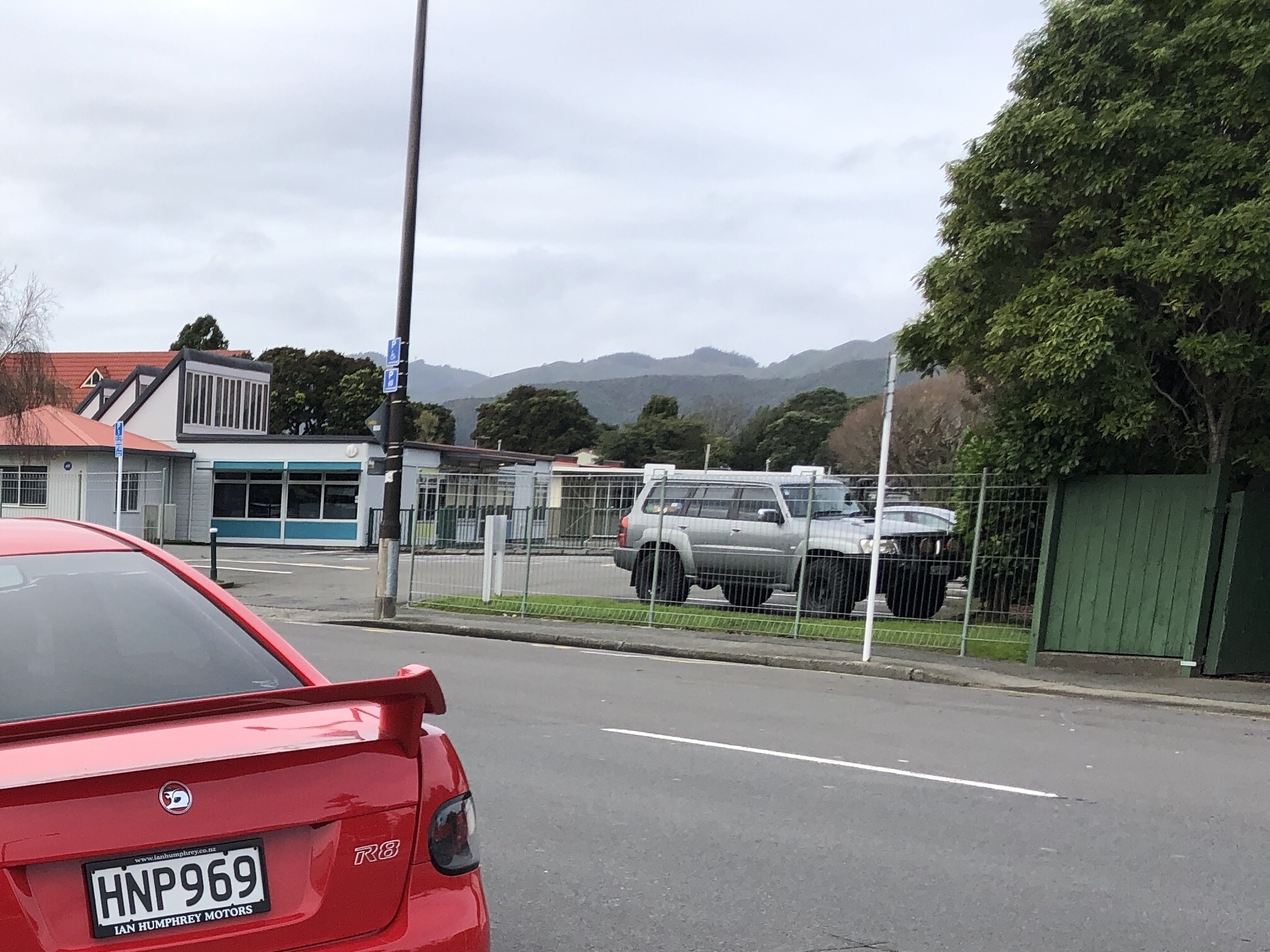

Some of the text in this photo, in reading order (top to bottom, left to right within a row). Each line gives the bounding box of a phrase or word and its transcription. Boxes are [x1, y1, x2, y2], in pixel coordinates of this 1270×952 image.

[134, 847, 217, 864] www.ianhumphrey.co.nz
[353, 839, 401, 866] R8
[97, 855, 258, 919] HNP969
[114, 904, 253, 936] IAN HUMPHREY MOTORS
